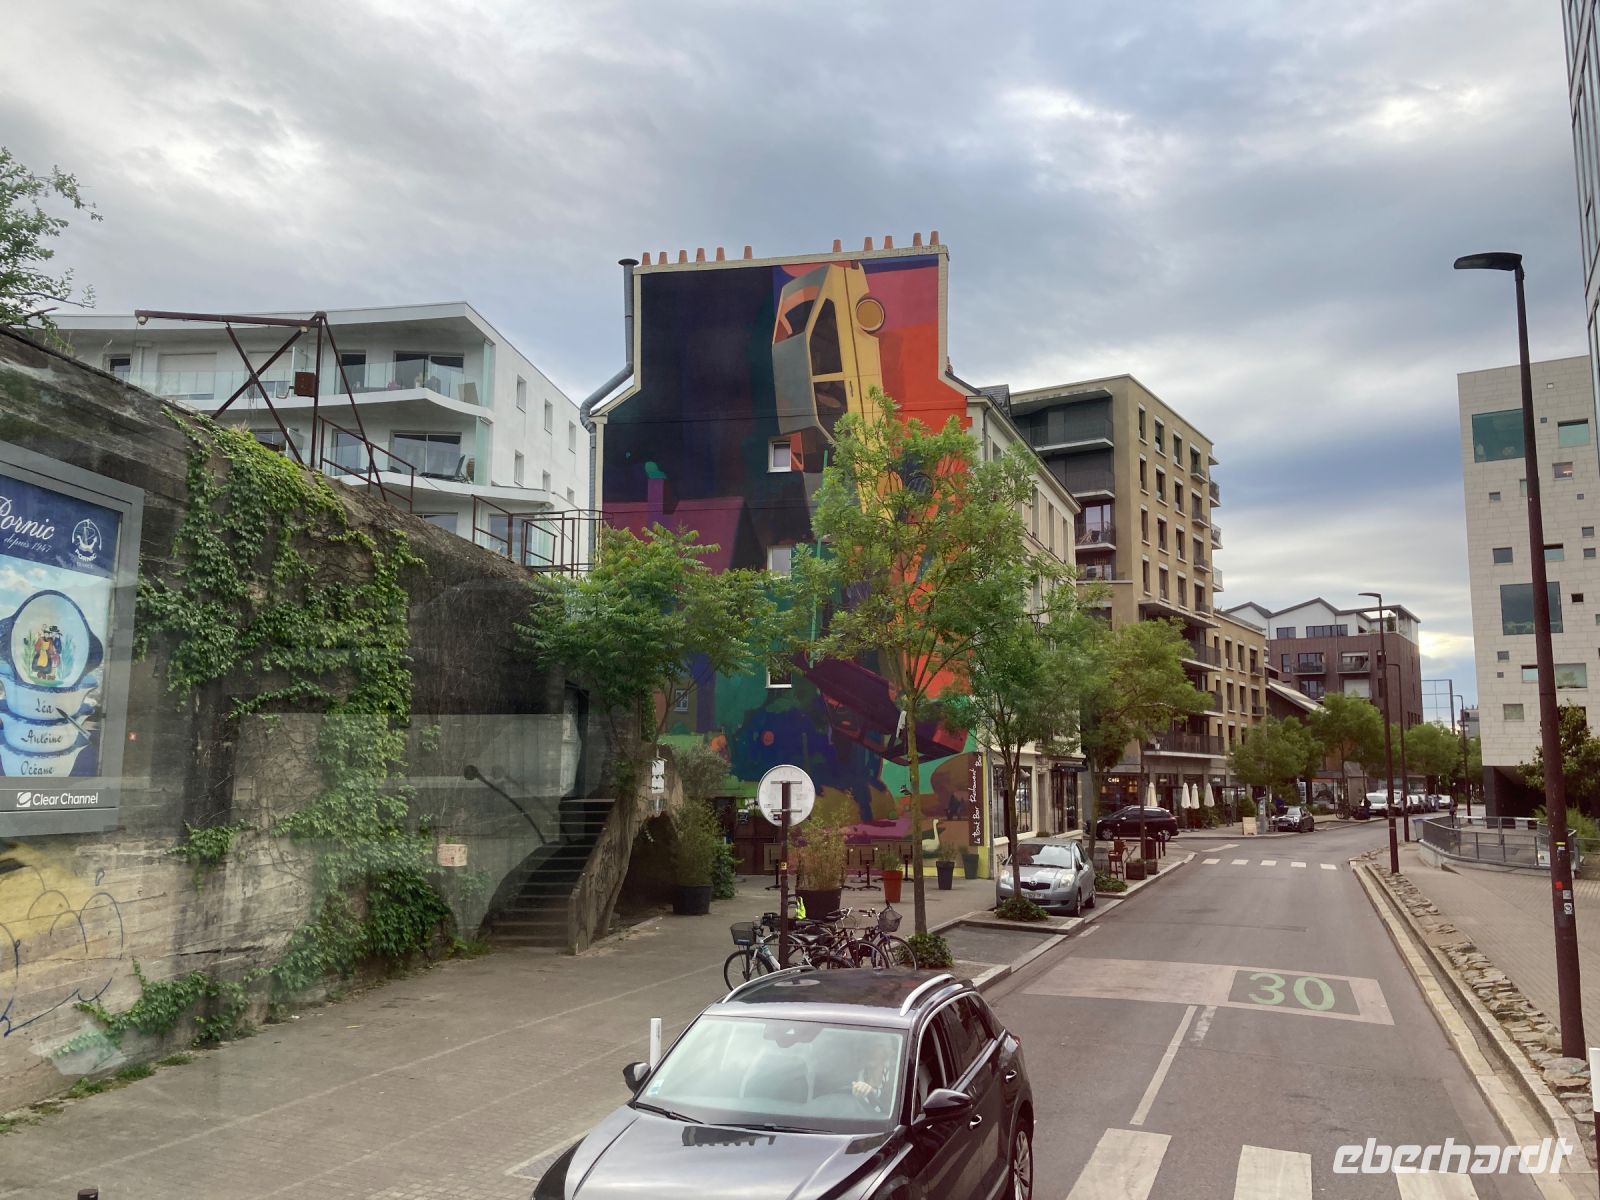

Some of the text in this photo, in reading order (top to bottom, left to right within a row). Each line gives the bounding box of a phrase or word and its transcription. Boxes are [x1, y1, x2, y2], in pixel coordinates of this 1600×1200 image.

[32, 792, 99, 806] Clear Channel
[1248, 972, 1336, 1012] 30
